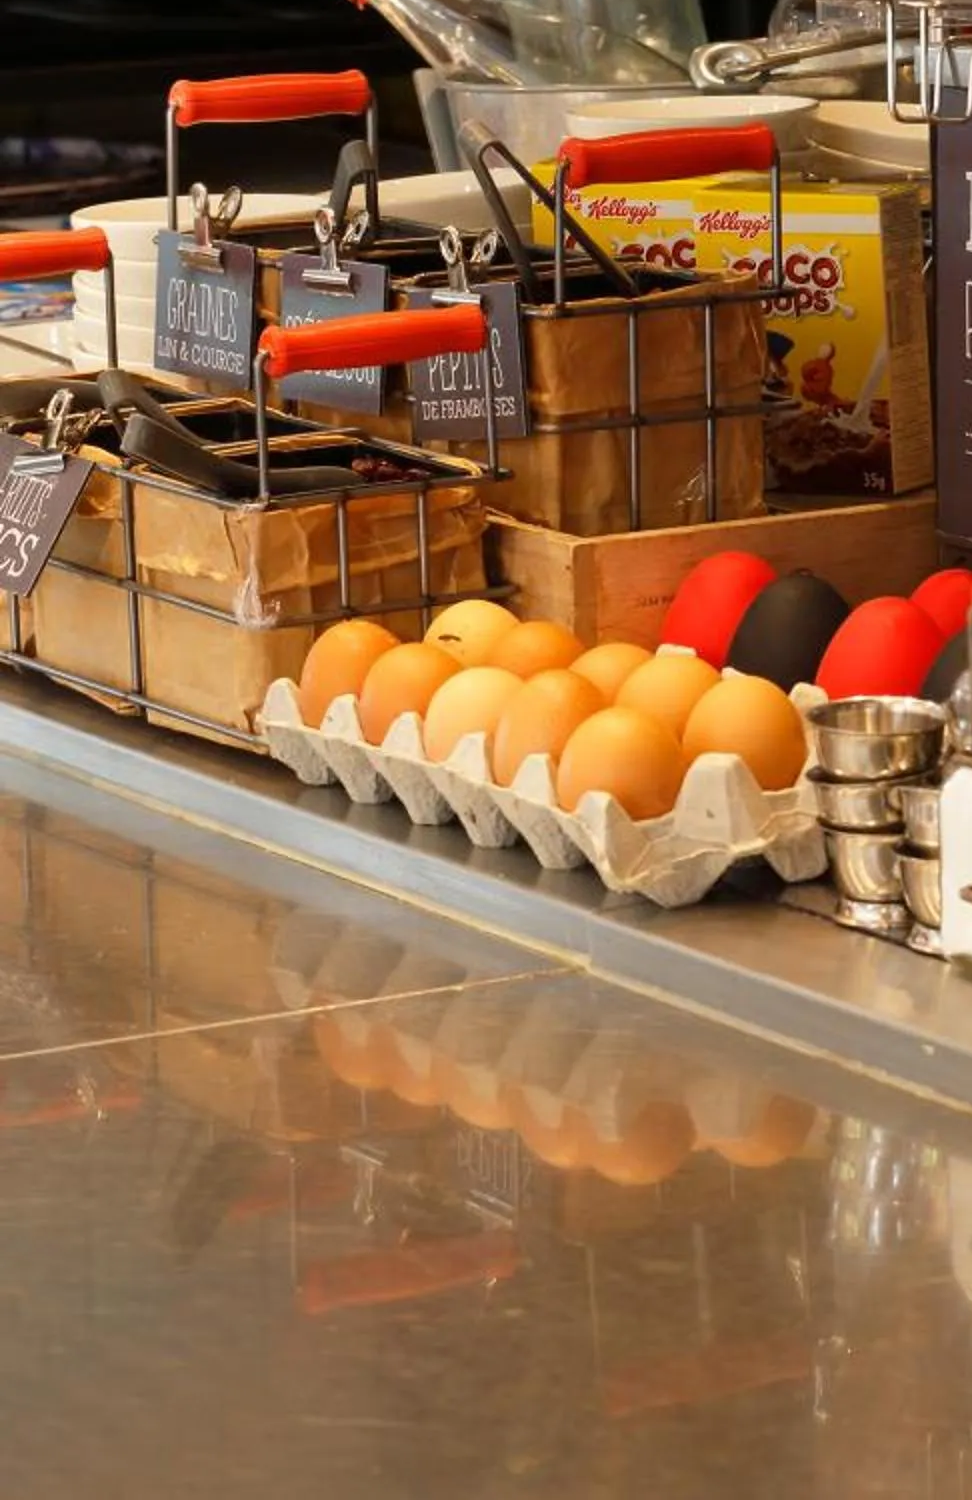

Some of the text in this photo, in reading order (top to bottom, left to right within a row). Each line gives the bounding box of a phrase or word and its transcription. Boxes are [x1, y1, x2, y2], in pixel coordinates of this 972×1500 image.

[587, 195, 658, 225] Kellogg's
[700, 209, 771, 239] Kellogg's
[167, 277, 239, 344] GRAINES
[157, 335, 246, 376] LIN & COURGE
[421, 401, 440, 421] DE
